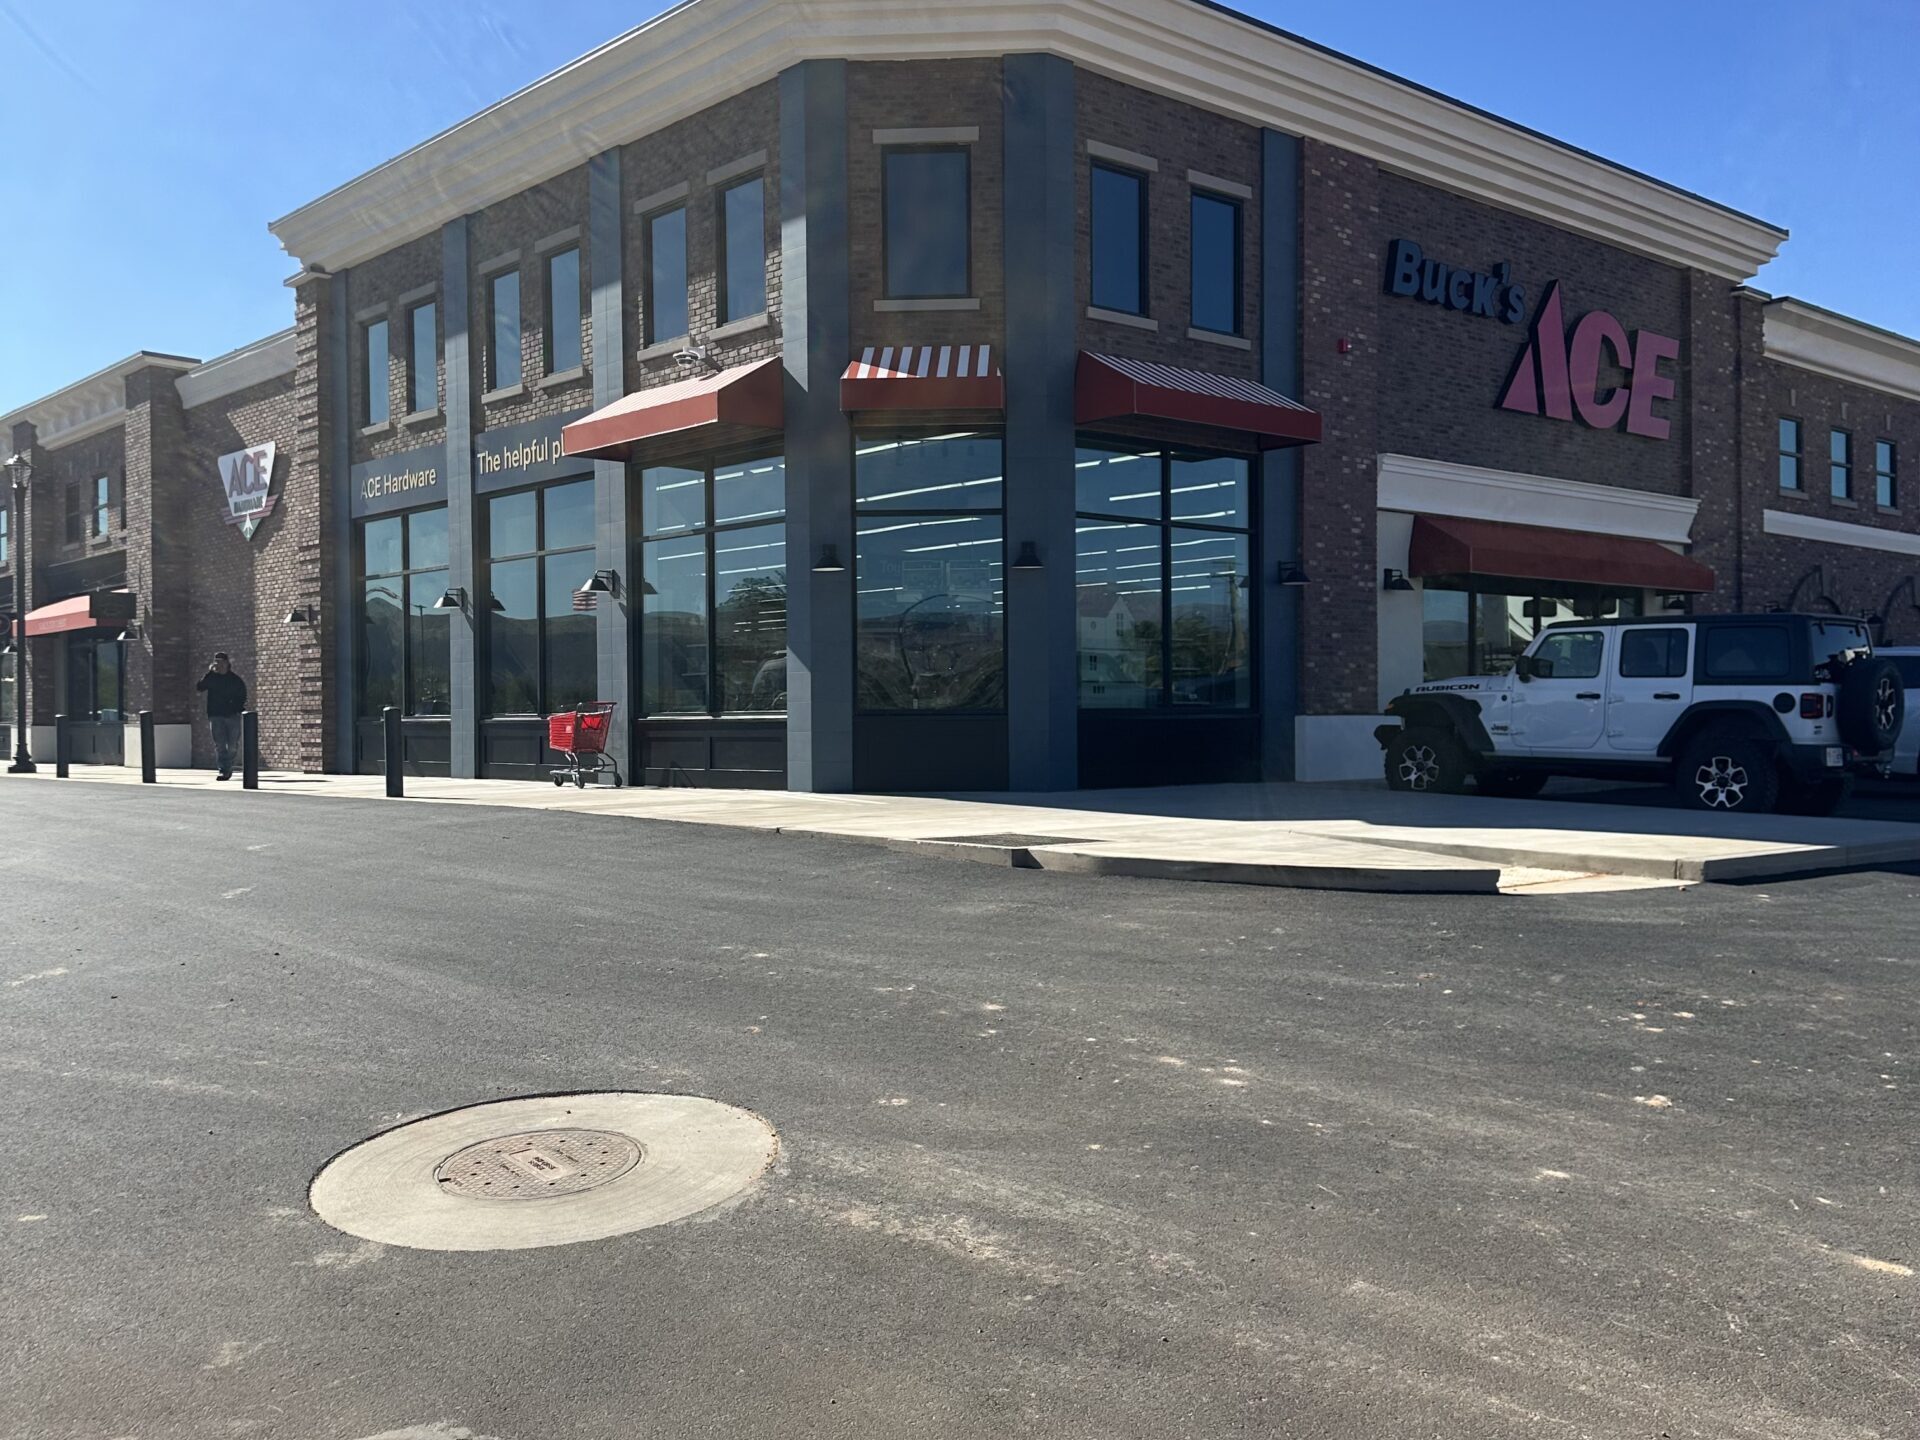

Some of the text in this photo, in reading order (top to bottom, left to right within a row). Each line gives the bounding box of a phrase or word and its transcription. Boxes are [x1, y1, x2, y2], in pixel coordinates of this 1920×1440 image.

[1498, 279, 1680, 441] ACE
[228, 449, 268, 498] ACE
[477, 450, 501, 475] The
[504, 436, 548, 471] helpful
[361, 468, 436, 500] ACE Hardware
[1415, 684, 1479, 692] RUBICON
